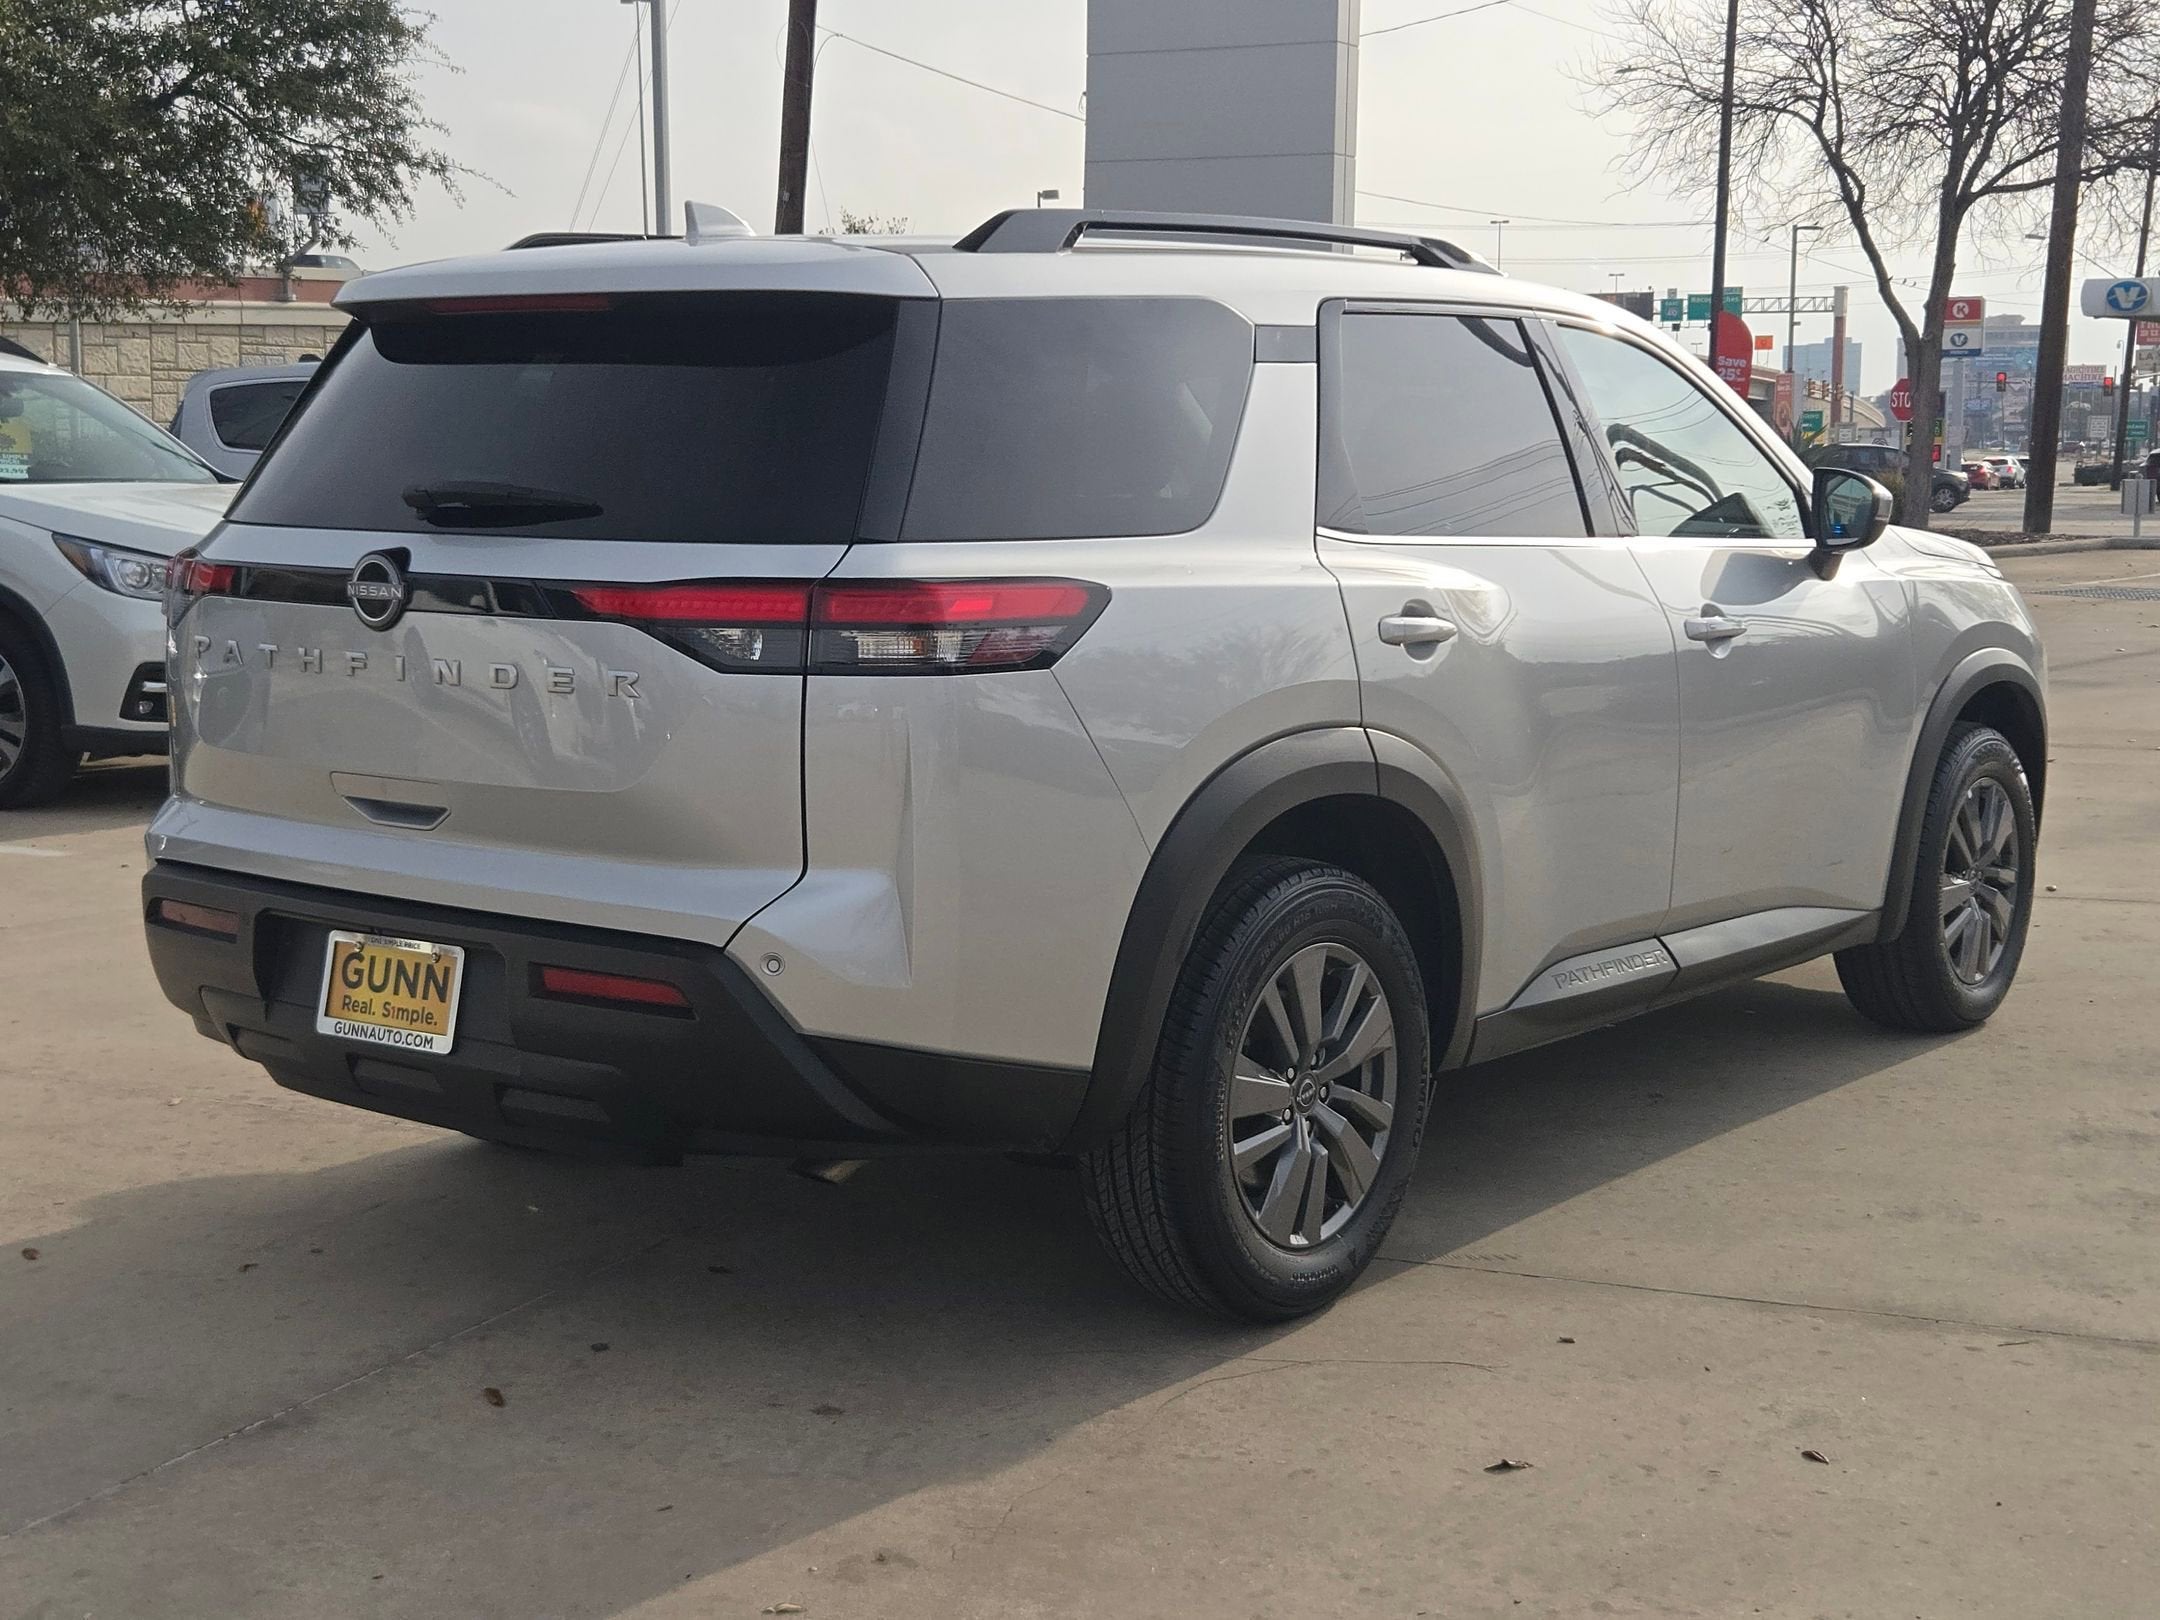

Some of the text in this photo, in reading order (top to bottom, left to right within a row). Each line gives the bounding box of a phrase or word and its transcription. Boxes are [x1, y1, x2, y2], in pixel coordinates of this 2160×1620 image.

[1717, 356, 1747, 368] Save
[1891, 392, 1911, 408] STO
[347, 584, 402, 599] NISSAN
[192, 635, 642, 699] PATHFINDER
[341, 951, 450, 1003] GUNN
[1551, 949, 1669, 990] PATHFINDER
[341, 994, 376, 1016] Real.
[334, 1021, 434, 1050] GUNNAUTO.COM
